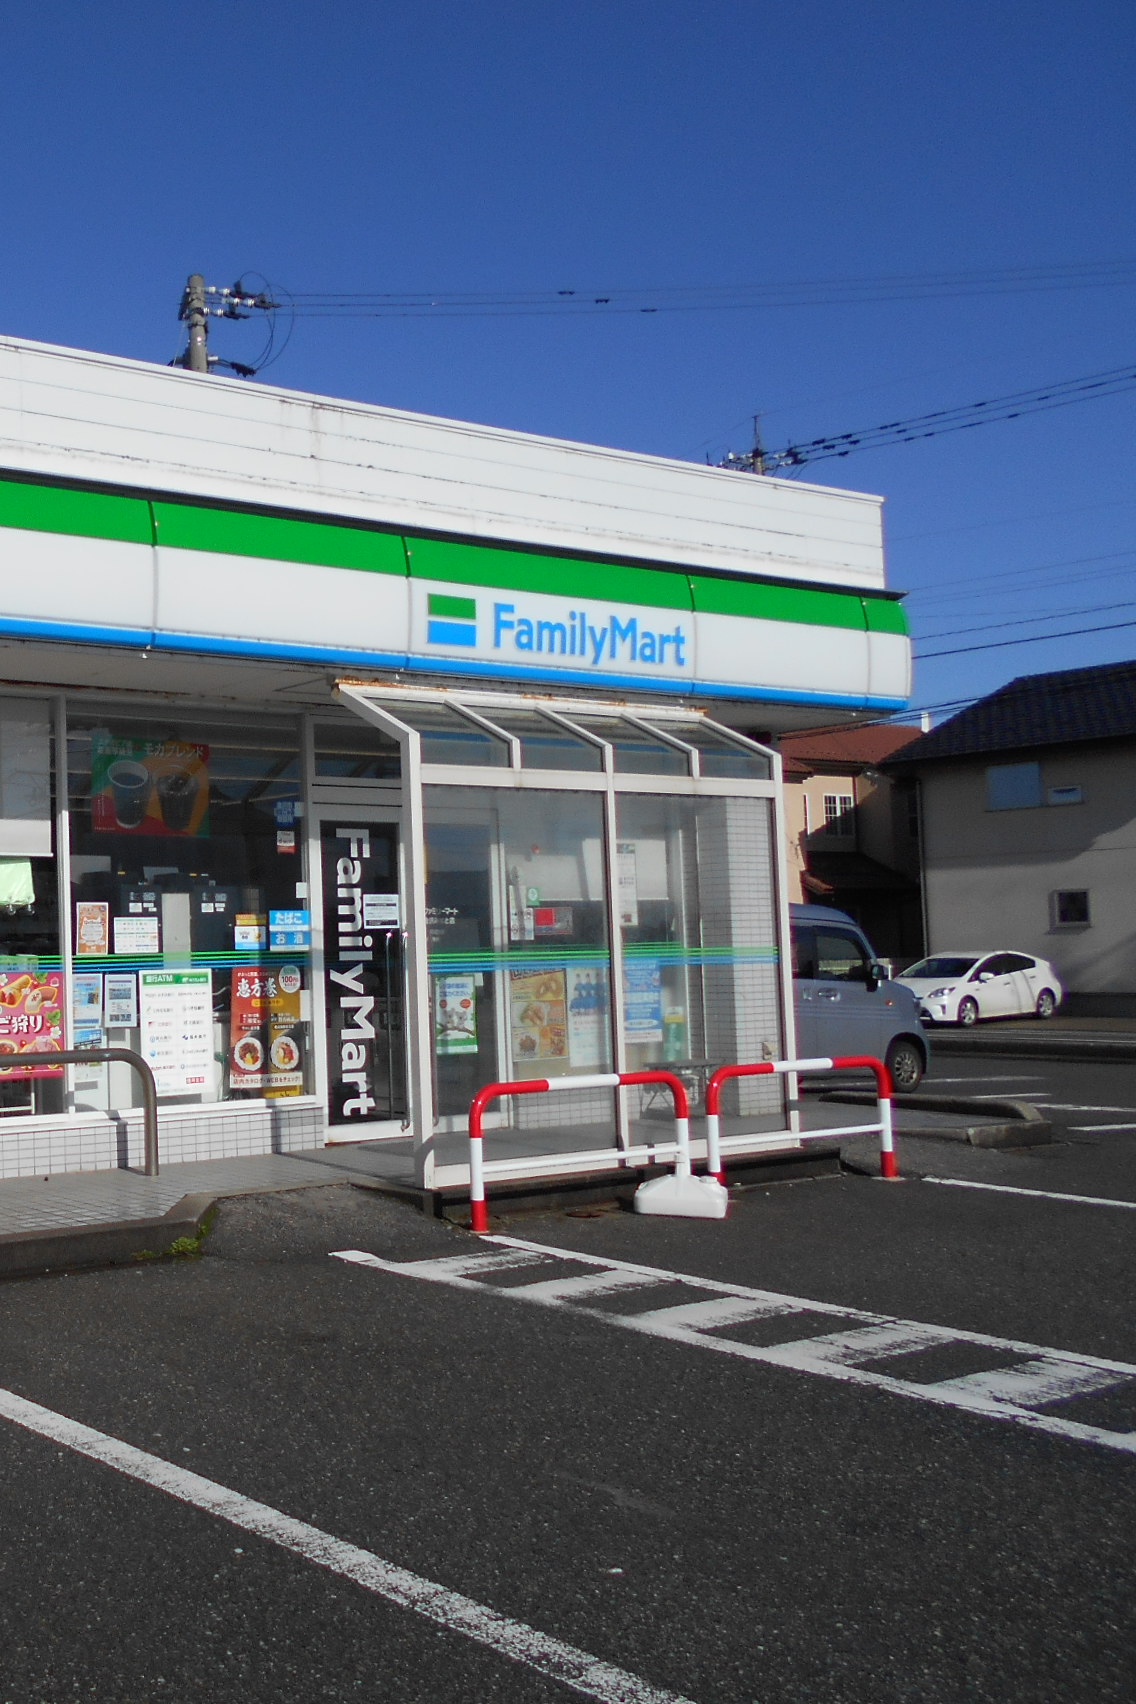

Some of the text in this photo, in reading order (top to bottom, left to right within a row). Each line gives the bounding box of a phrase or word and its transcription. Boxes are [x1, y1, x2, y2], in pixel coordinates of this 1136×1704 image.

[493, 603, 685, 667] FamilyMart
[275, 912, 303, 925] たばこ
[236, 977, 277, 998] 恵方巻
[329, 828, 376, 1117] FamilyMart
